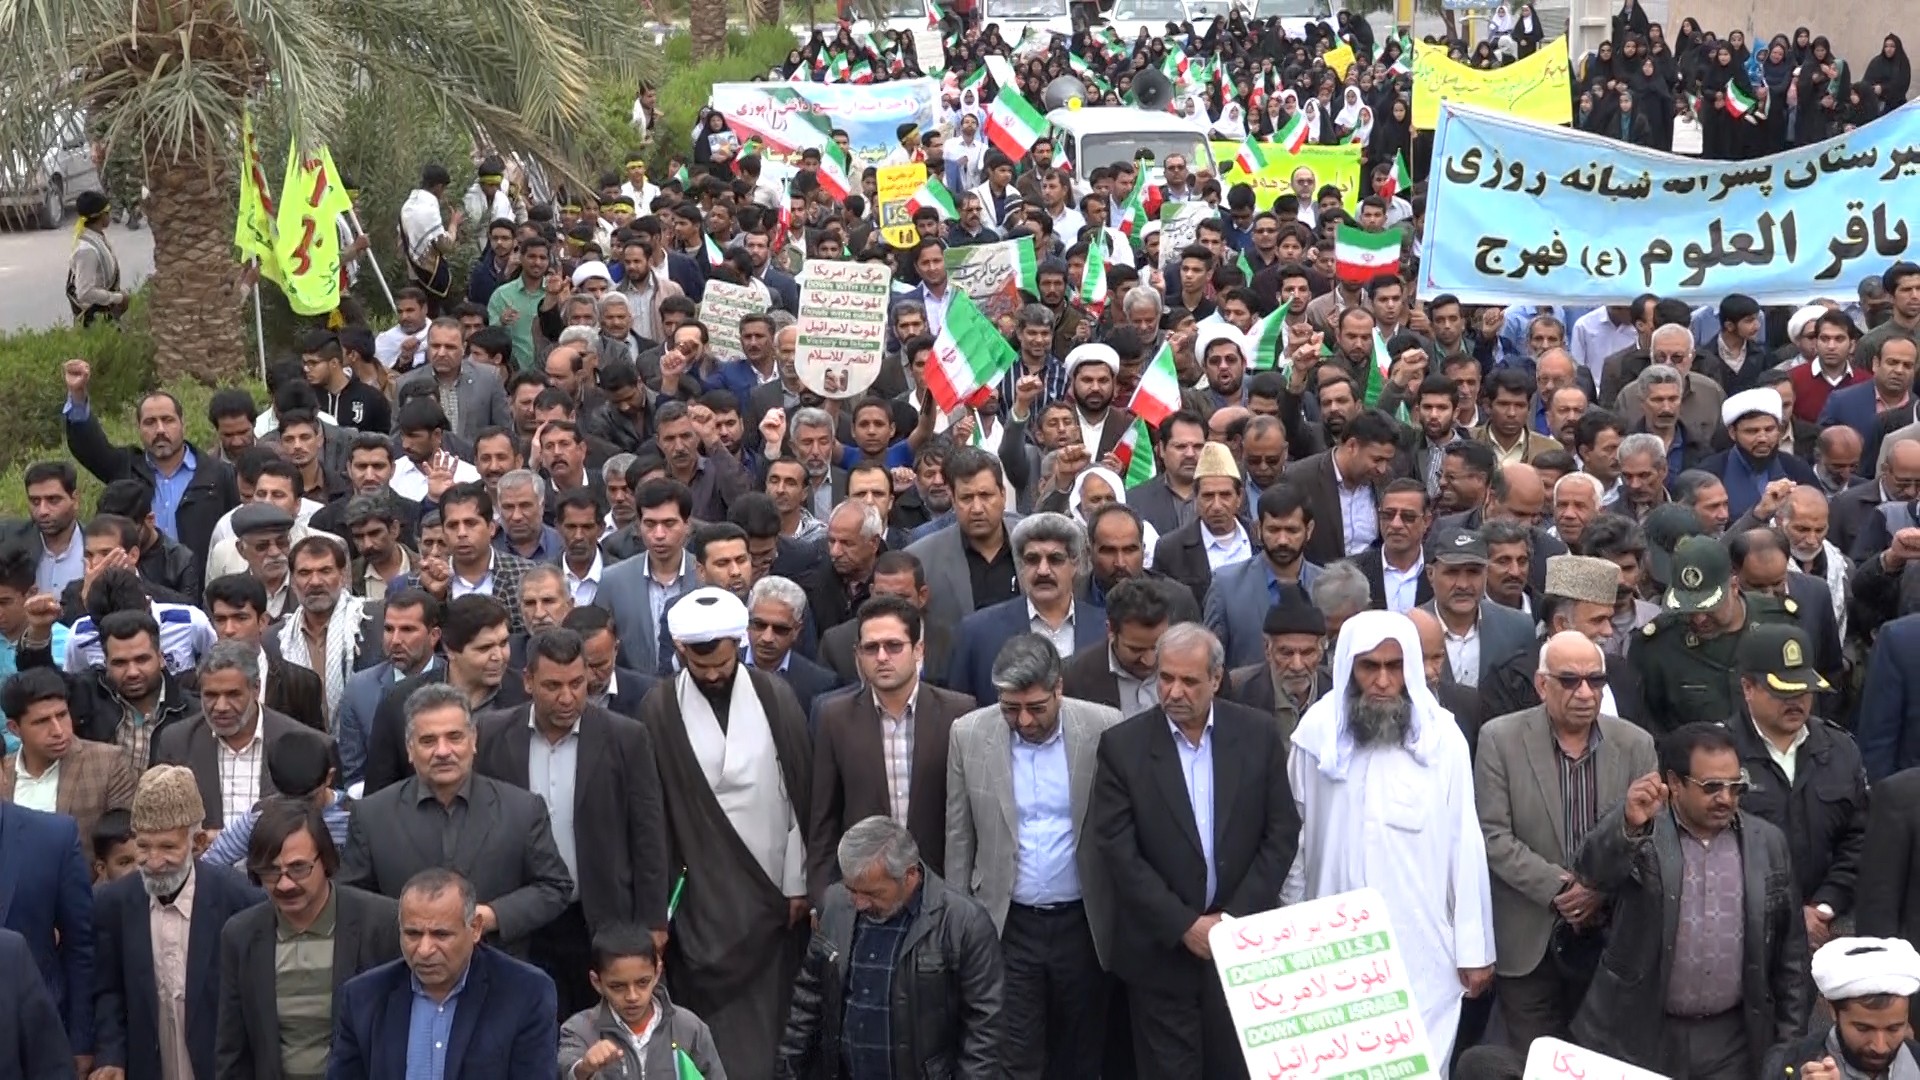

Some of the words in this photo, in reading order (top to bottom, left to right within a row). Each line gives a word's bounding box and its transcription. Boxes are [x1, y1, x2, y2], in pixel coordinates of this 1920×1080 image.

[1446, 147, 1546, 197] روزی
[1561, 161, 1651, 201] شبانه
[1784, 144, 1920, 189] یرستان
[1475, 230, 1568, 279] فهرج
[1581, 245, 1627, 277] (ع)
[1641, 209, 1798, 287] العلوم
[861, 268, 883, 282] مرگ
[1304, 921, 1324, 942] بر
[1329, 902, 1370, 932] مرگ
[1232, 921, 1297, 954] امریکا
[1229, 957, 1287, 986] DOWN
[1289, 944, 1334, 971] WITH
[1335, 959, 1392, 993] الموت
[1250, 973, 1327, 1014] لامریکا
[1248, 1016, 1301, 1043] DOWN
[1302, 1005, 1345, 1031] WITH
[1349, 992, 1407, 1020] ISRAEL
[1356, 1018, 1414, 1055] الموت
